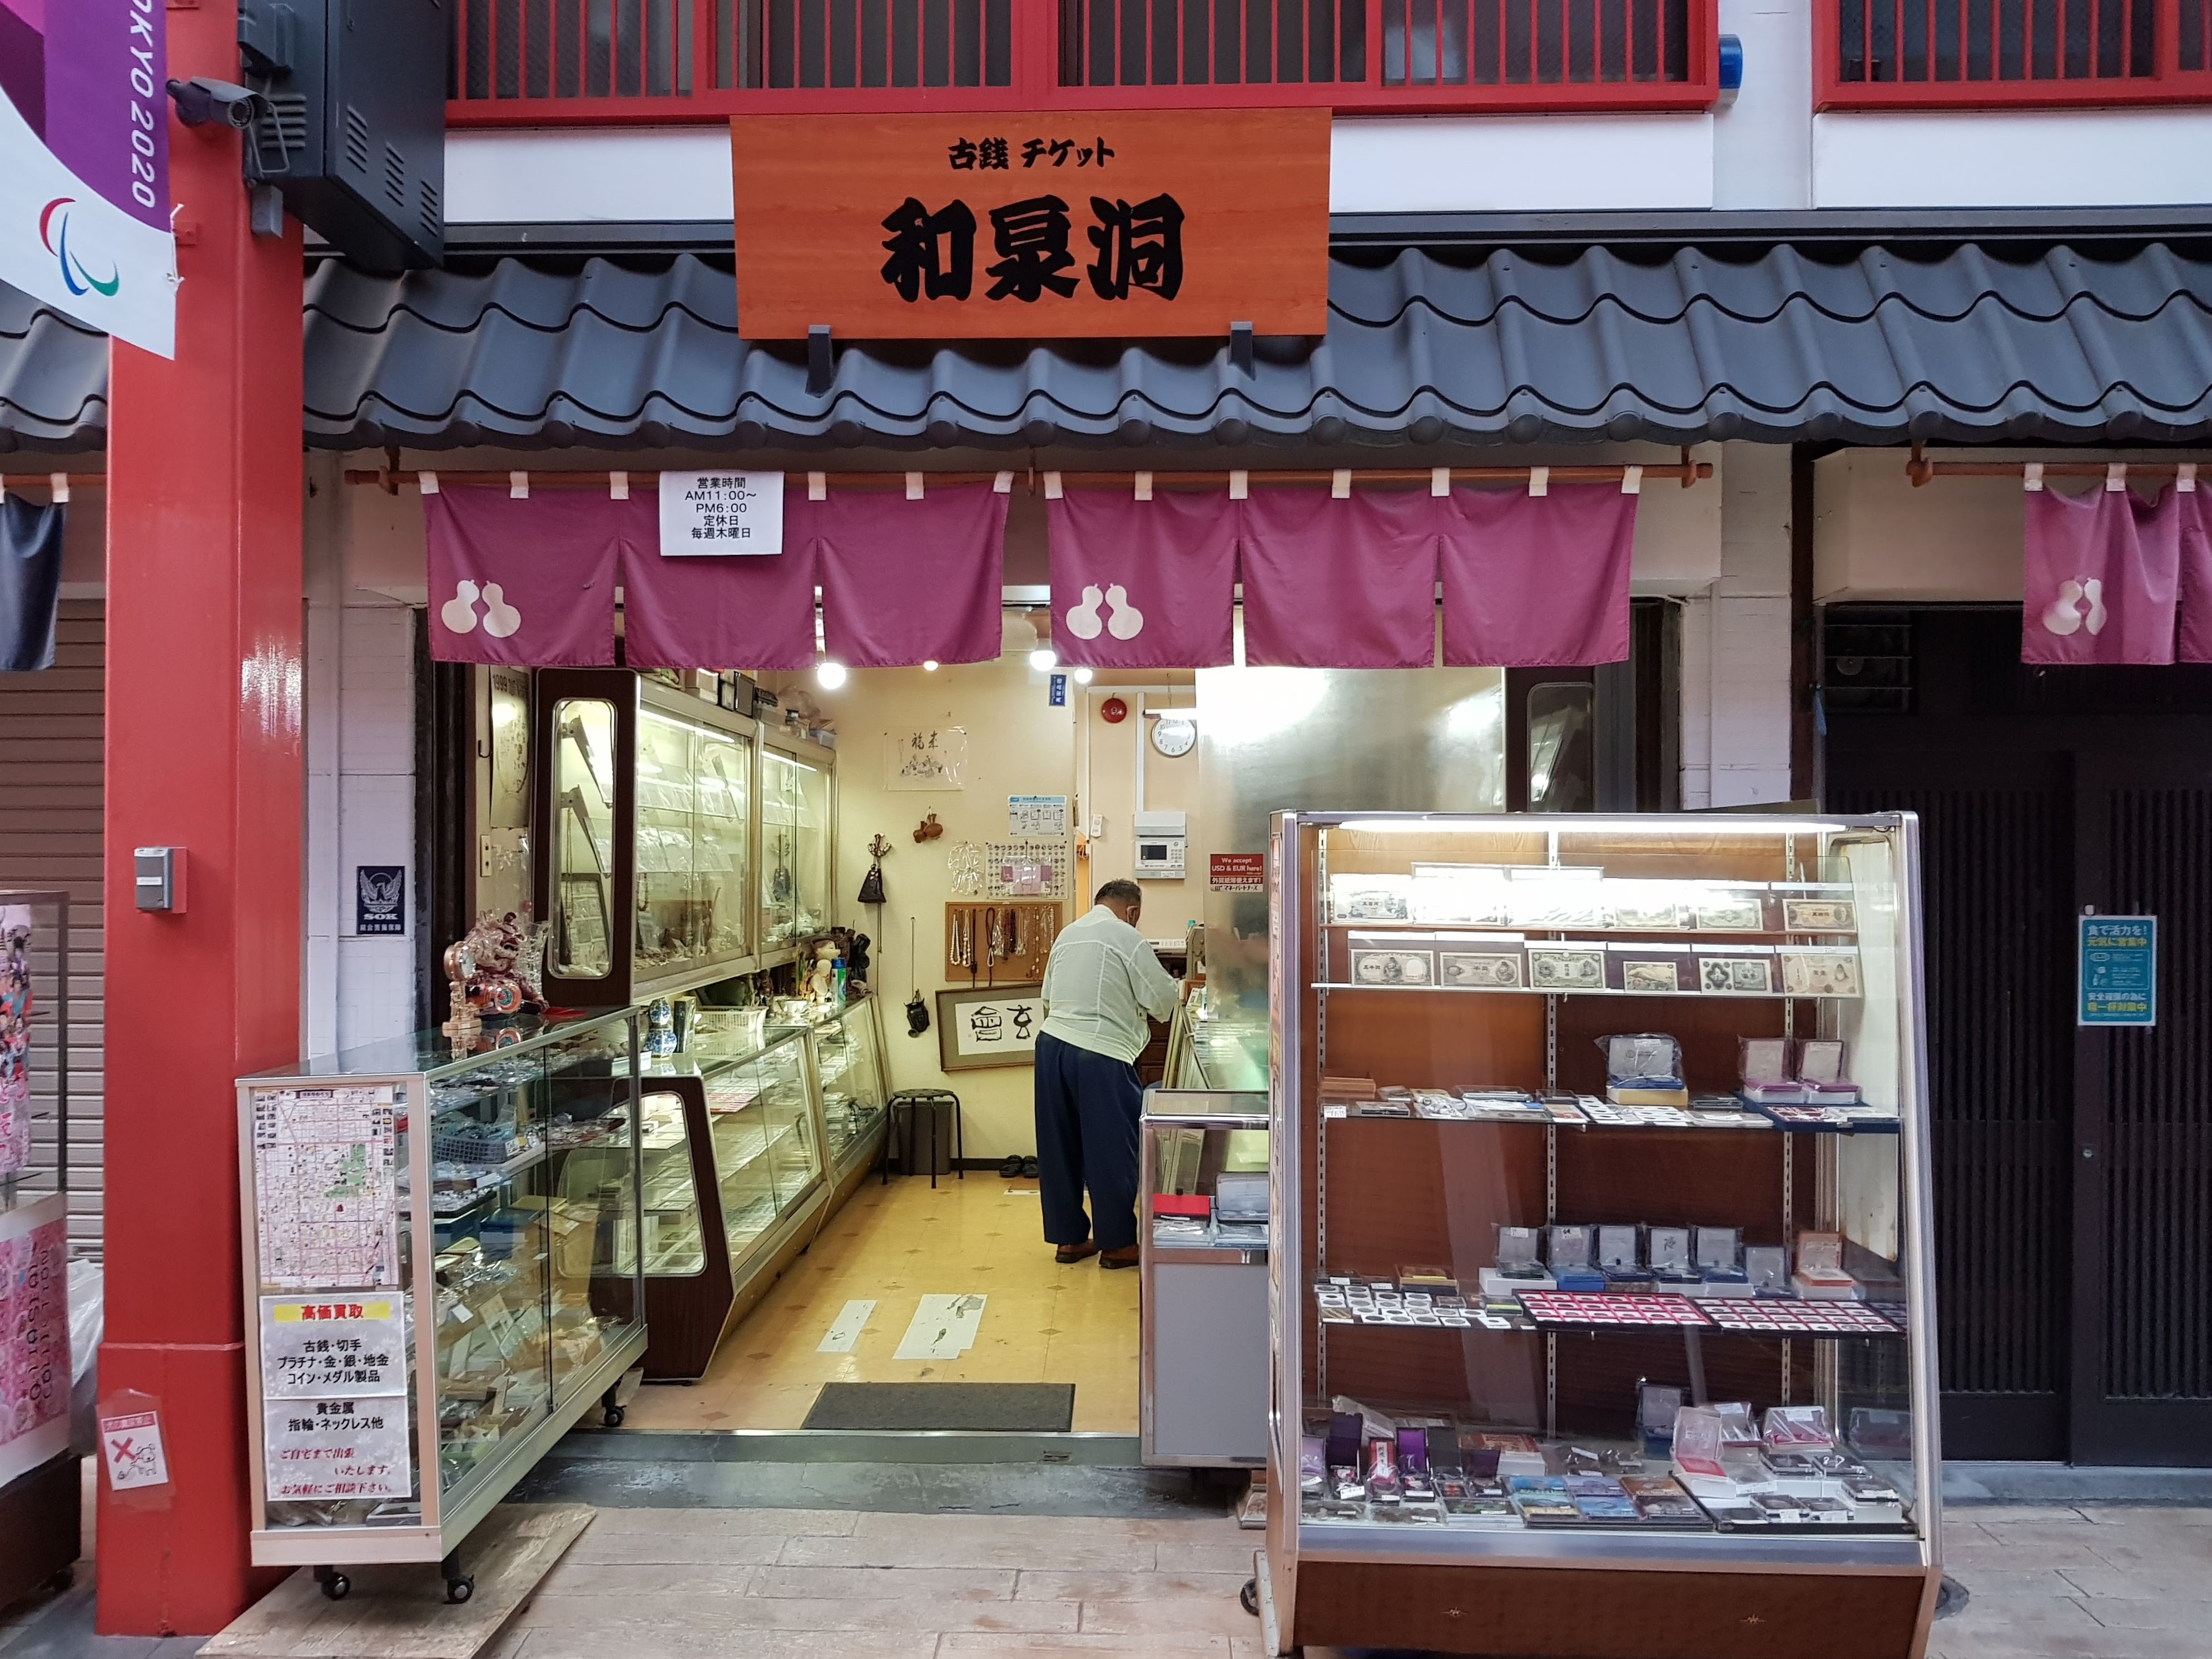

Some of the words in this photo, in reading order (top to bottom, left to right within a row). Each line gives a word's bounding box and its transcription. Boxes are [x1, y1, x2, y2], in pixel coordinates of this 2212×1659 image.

[131, 100, 155, 208] 2020
[1021, 136, 1115, 168] チケット
[881, 193, 1185, 303] 和泉洞
[697, 477, 746, 489] 営業時間
[696, 503, 747, 513] PM6:00
[703, 514, 738, 527] 定休日
[691, 527, 751, 539] 毎週木曜日
[301, 1304, 364, 1320] 高価買取
[303, 1339, 362, 1353] 古銭・切手
[278, 1353, 389, 1369] プラチナ・金・銀・地金
[287, 1369, 380, 1385] コイン・メダル製品
[316, 1402, 354, 1415] 貴金属
[288, 1417, 384, 1432] 指輪・ネックレス他
[281, 1448, 356, 1460] ご自宅まで出張
[334, 1464, 390, 1475] いたします。
[281, 1482, 392, 1495] お気軽にご相談下さい。
